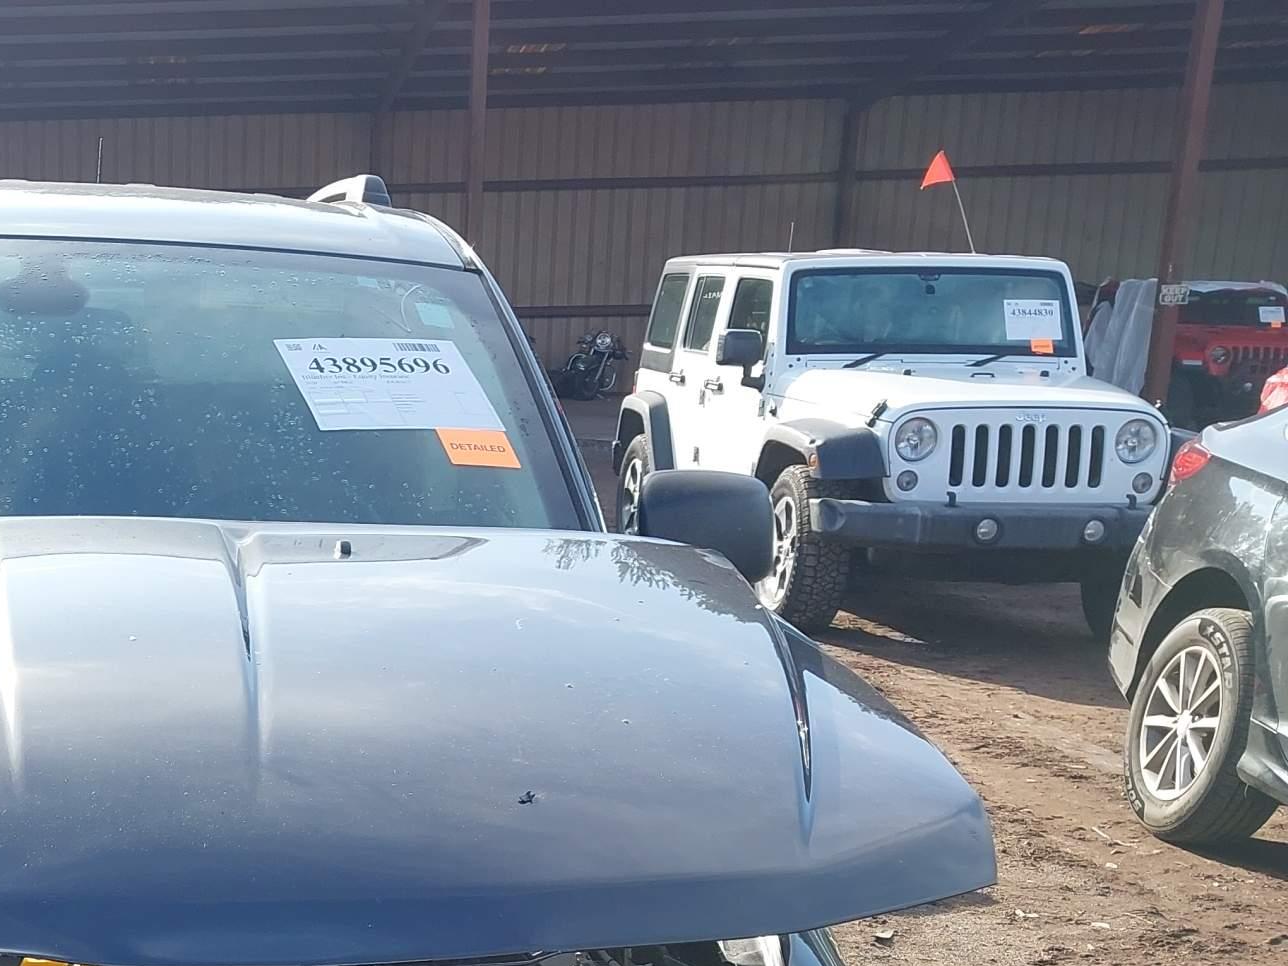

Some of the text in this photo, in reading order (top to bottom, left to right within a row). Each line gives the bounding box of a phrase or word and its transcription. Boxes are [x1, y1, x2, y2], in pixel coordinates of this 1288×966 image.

[309, 357, 450, 374] 43895696
[1016, 413, 1047, 423] Jeep
[450, 442, 506, 453] DETAILED
